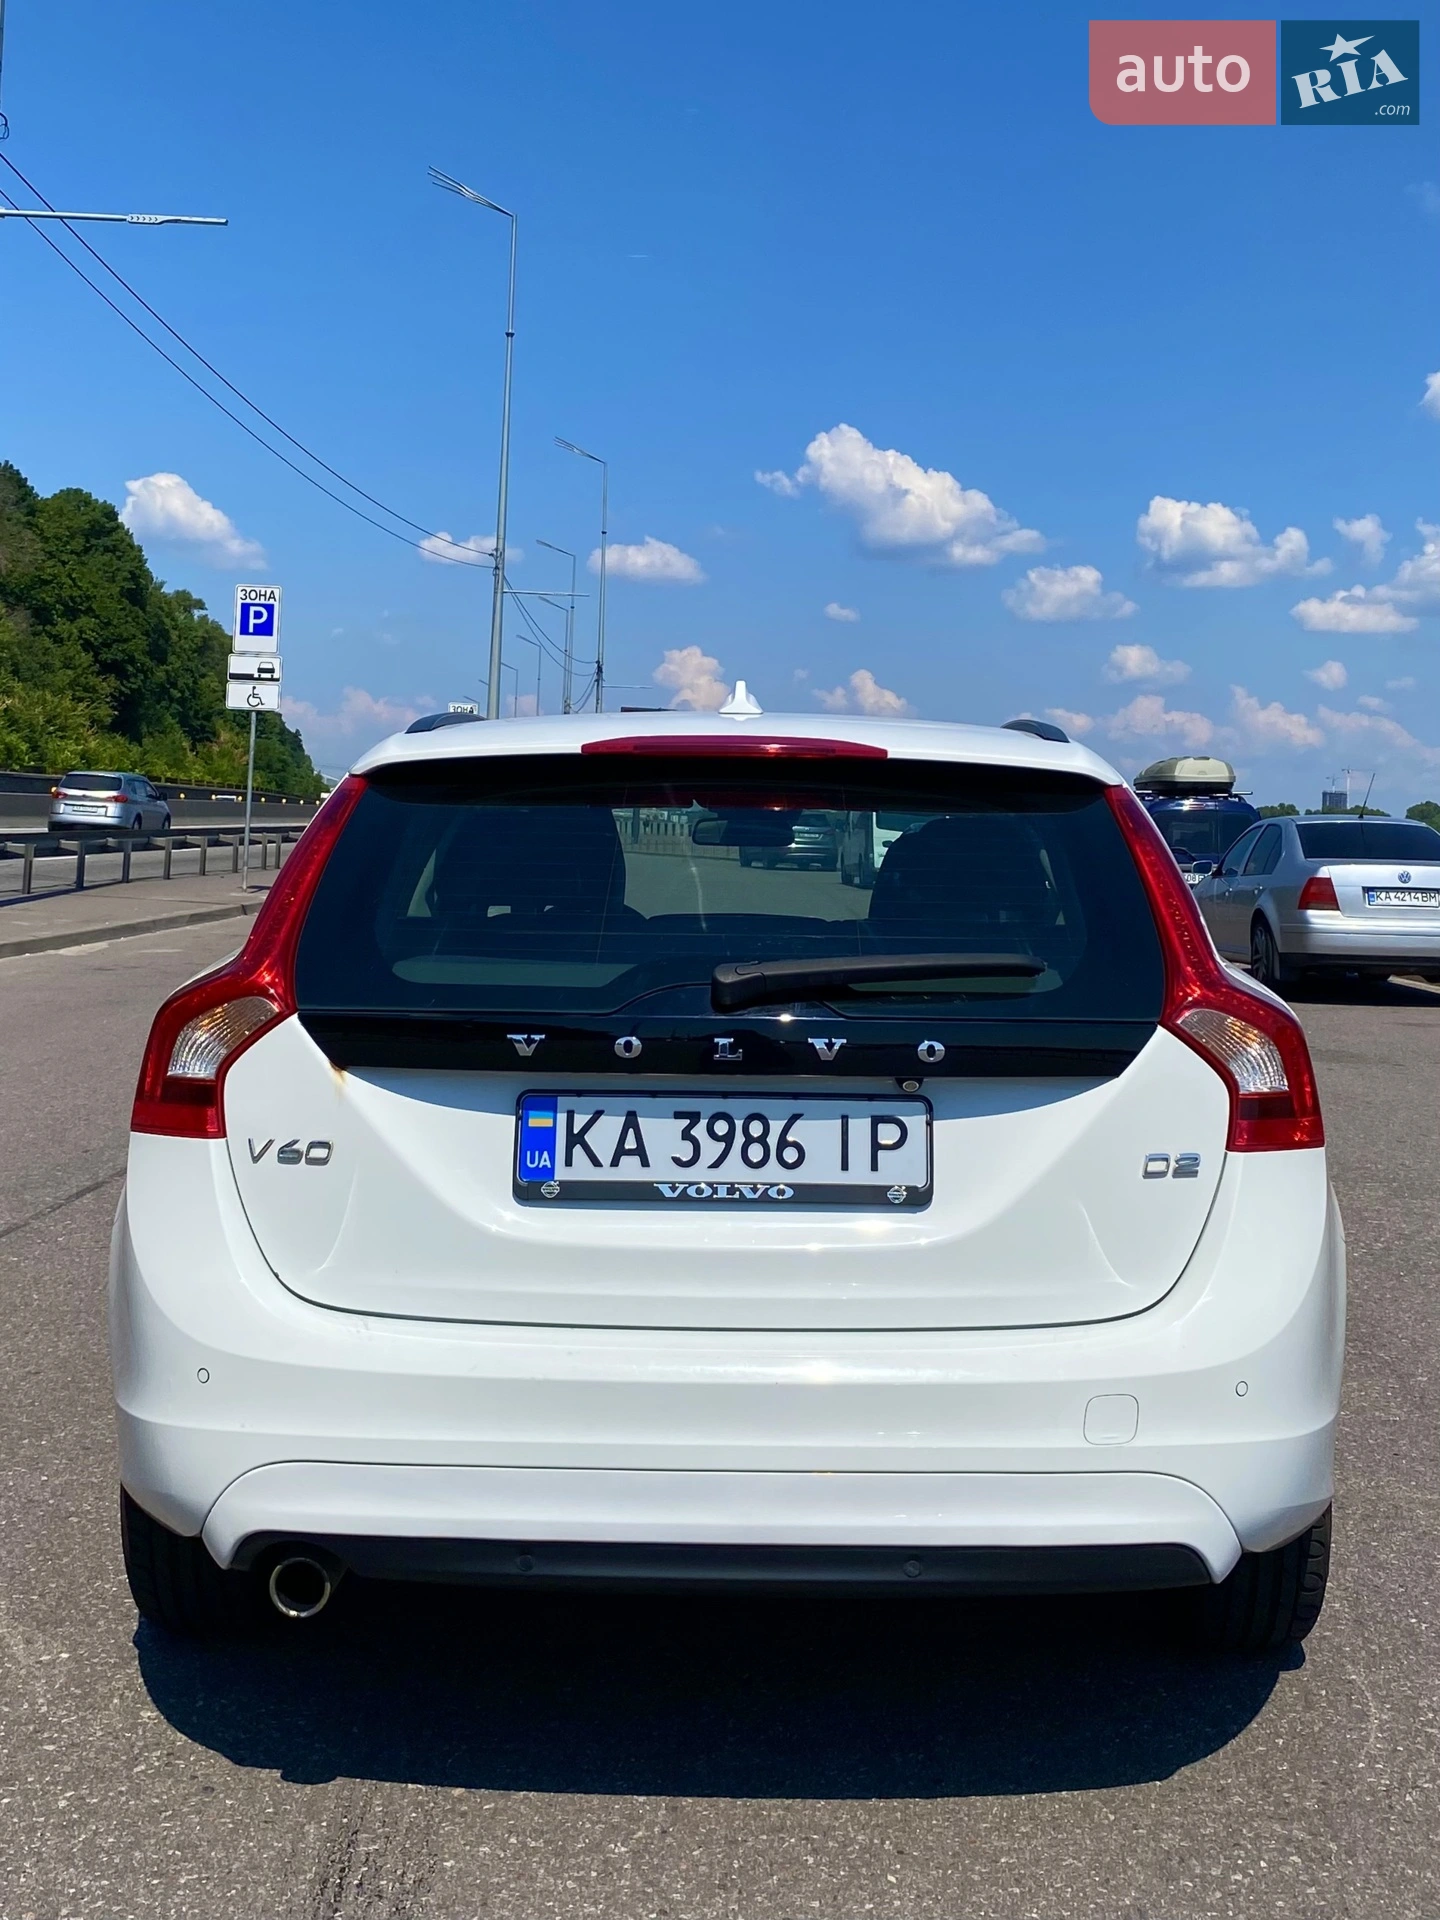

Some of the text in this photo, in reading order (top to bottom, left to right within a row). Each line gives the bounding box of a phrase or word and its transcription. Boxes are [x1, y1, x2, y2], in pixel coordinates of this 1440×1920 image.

[239, 588, 277, 603] ЗОНА
[1376, 891, 1392, 902] KA
[1394, 891, 1420, 902] 4214
[1421, 892, 1437, 903] BM
[506, 1033, 946, 1064] VOLVO
[248, 1138, 334, 1166] V60
[564, 1109, 909, 1172] KA 3986 IP
[526, 1150, 552, 1169] UA
[1142, 1152, 1202, 1180] D2
[653, 1183, 796, 1201] VOLVO
